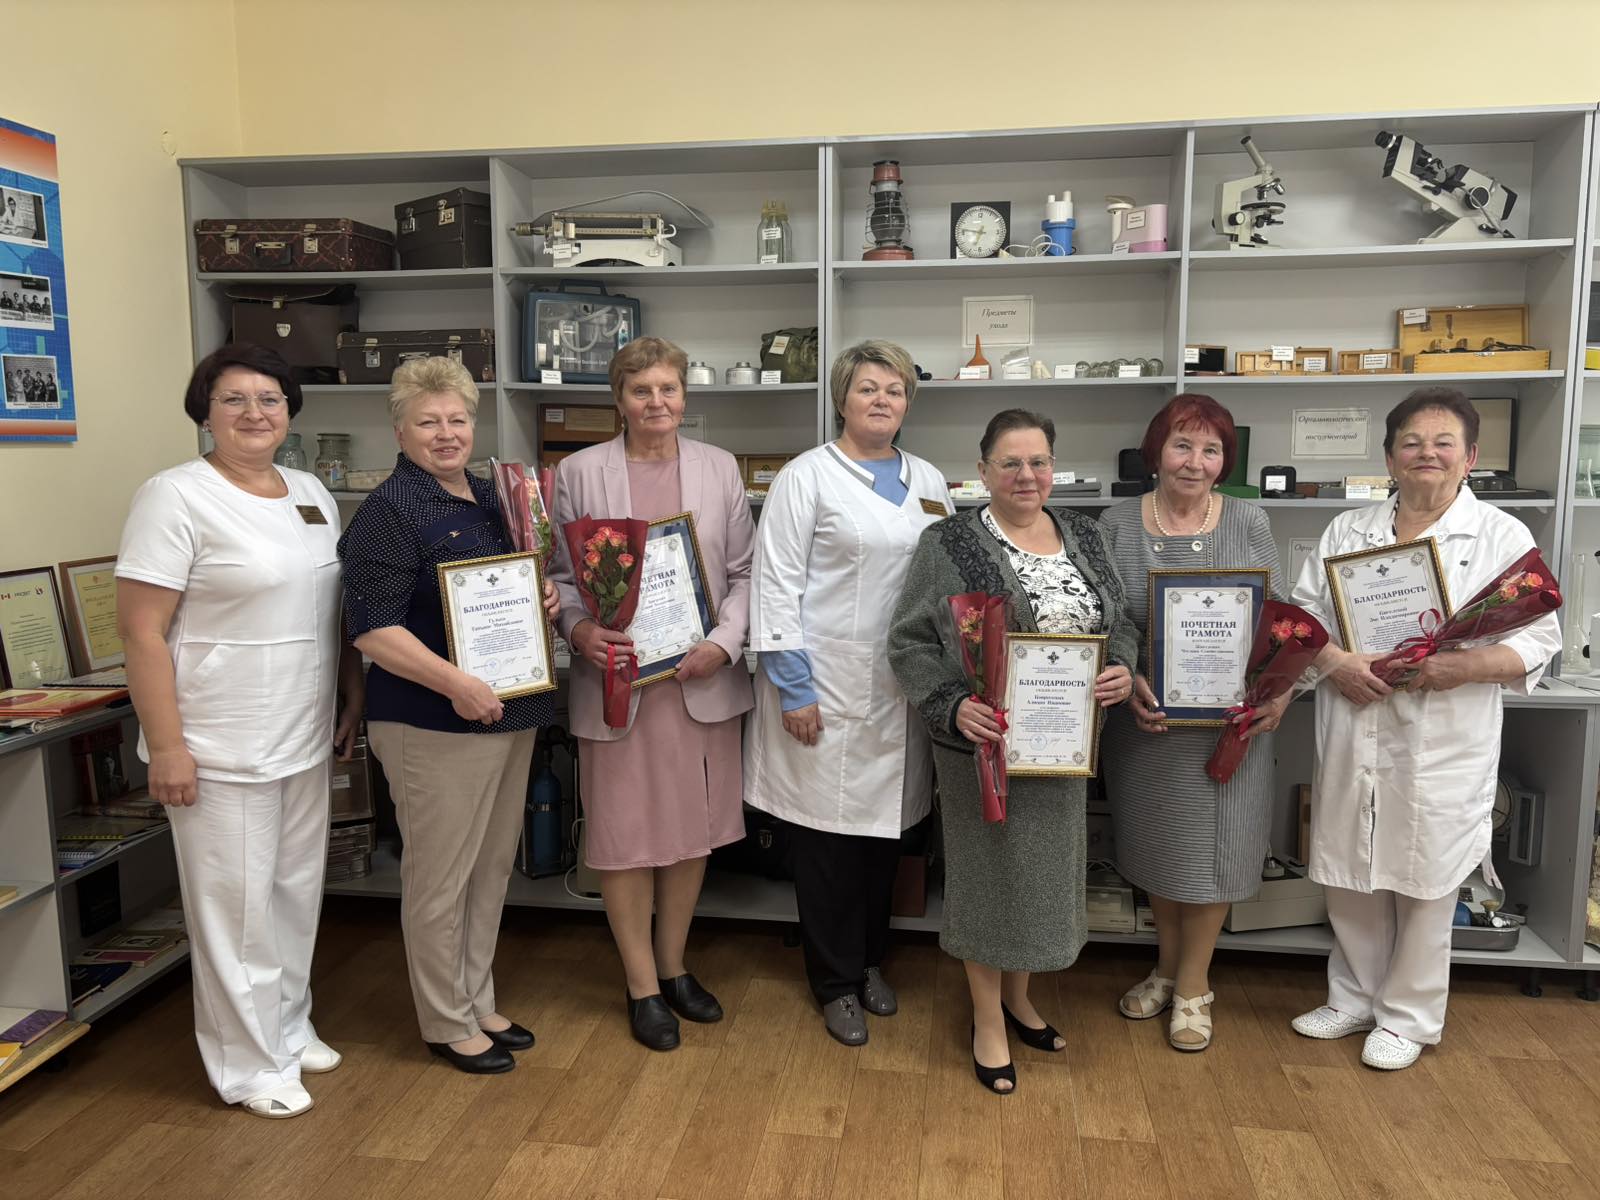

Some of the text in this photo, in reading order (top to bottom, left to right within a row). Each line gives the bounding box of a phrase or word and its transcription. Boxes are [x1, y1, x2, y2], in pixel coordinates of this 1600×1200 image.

[981, 308, 1017, 318] Предметы
[989, 322, 1008, 331] ухода
[640, 569, 676, 585] ЧЕТНАЯ
[639, 578, 676, 595] РАМОТА
[1353, 585, 1427, 604] БЛАГОДАРНОСТЬ
[463, 596, 530, 614] БЛАГОДАРНОСТЬ
[1180, 620, 1237, 629] ПОЧЕТНАЯ
[1185, 629, 1233, 638] ГРАМОТА
[1018, 679, 1087, 688] БЛАГОДАРНОСТЬ
